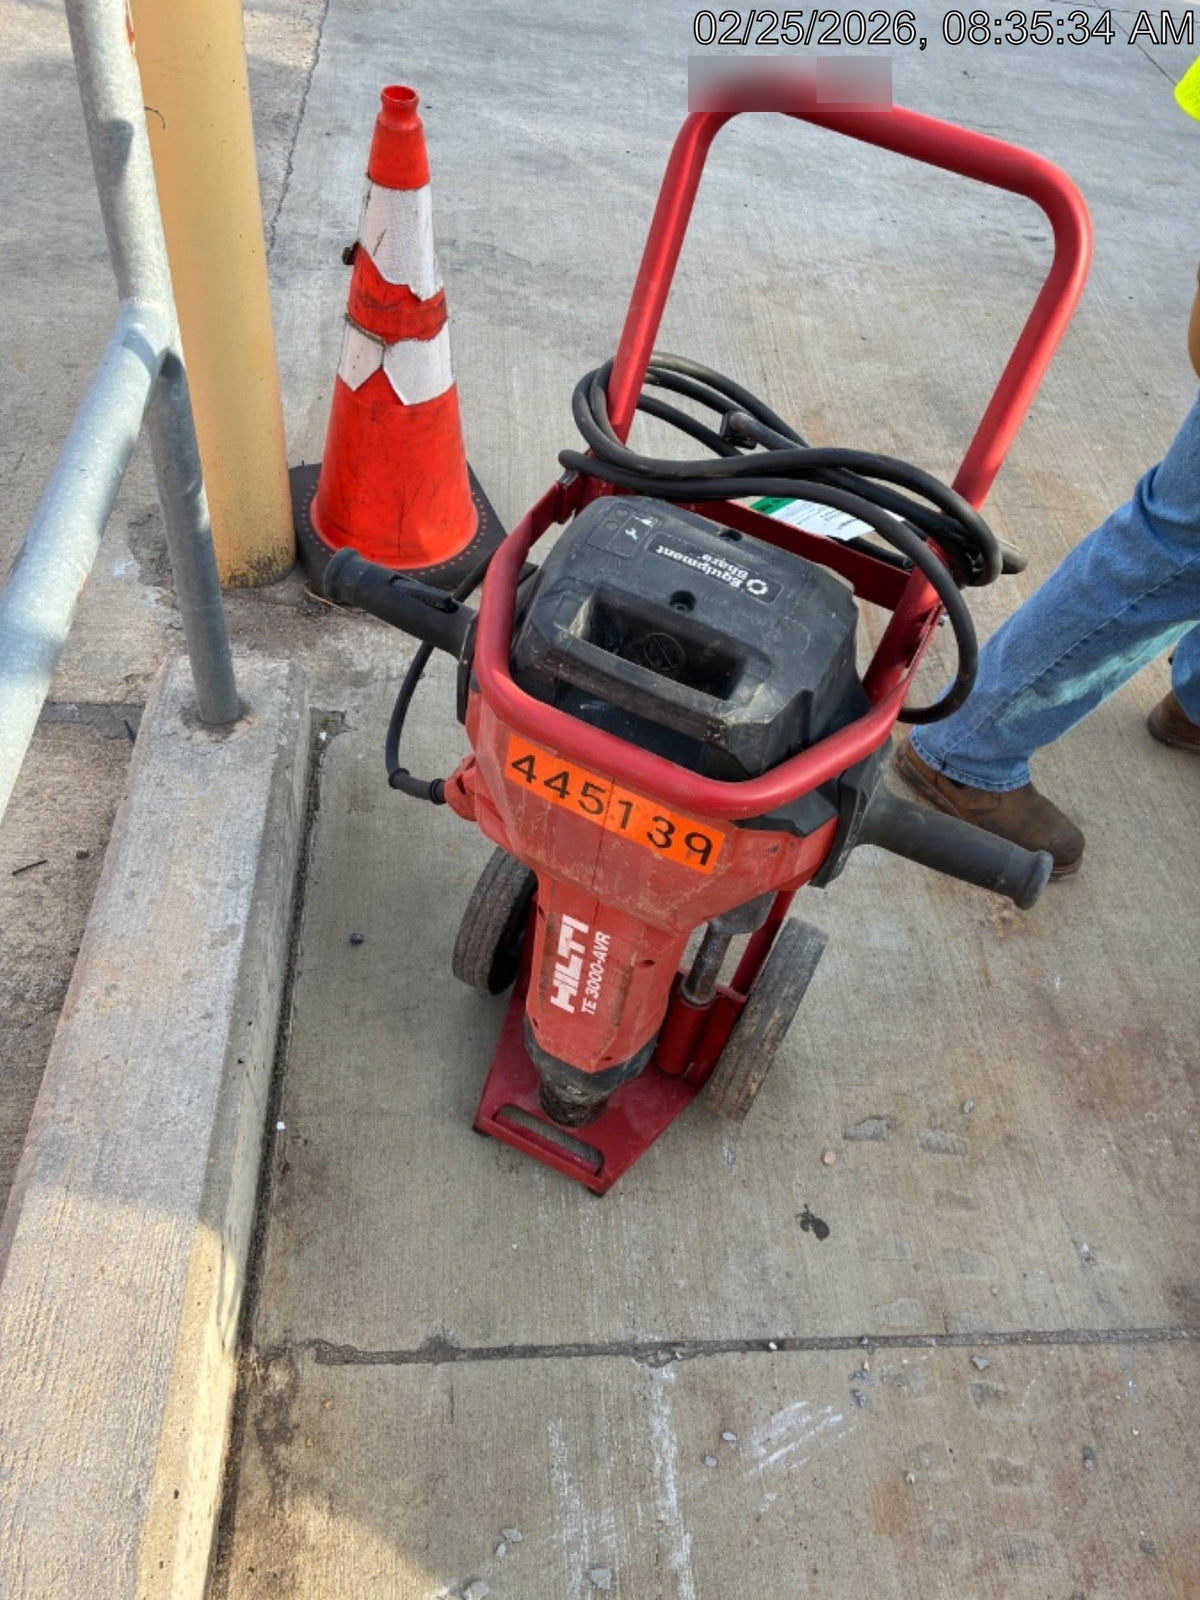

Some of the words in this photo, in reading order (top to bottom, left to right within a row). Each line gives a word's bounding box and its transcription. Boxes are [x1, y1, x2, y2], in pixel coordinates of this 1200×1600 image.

[655, 545, 743, 589] Equipment
[700, 552, 750, 580] Share
[510, 754, 714, 867] 445139
[550, 913, 590, 1014] HILTI
[584, 930, 612, 999] 3000-AVR
[580, 997, 598, 1016] TE
